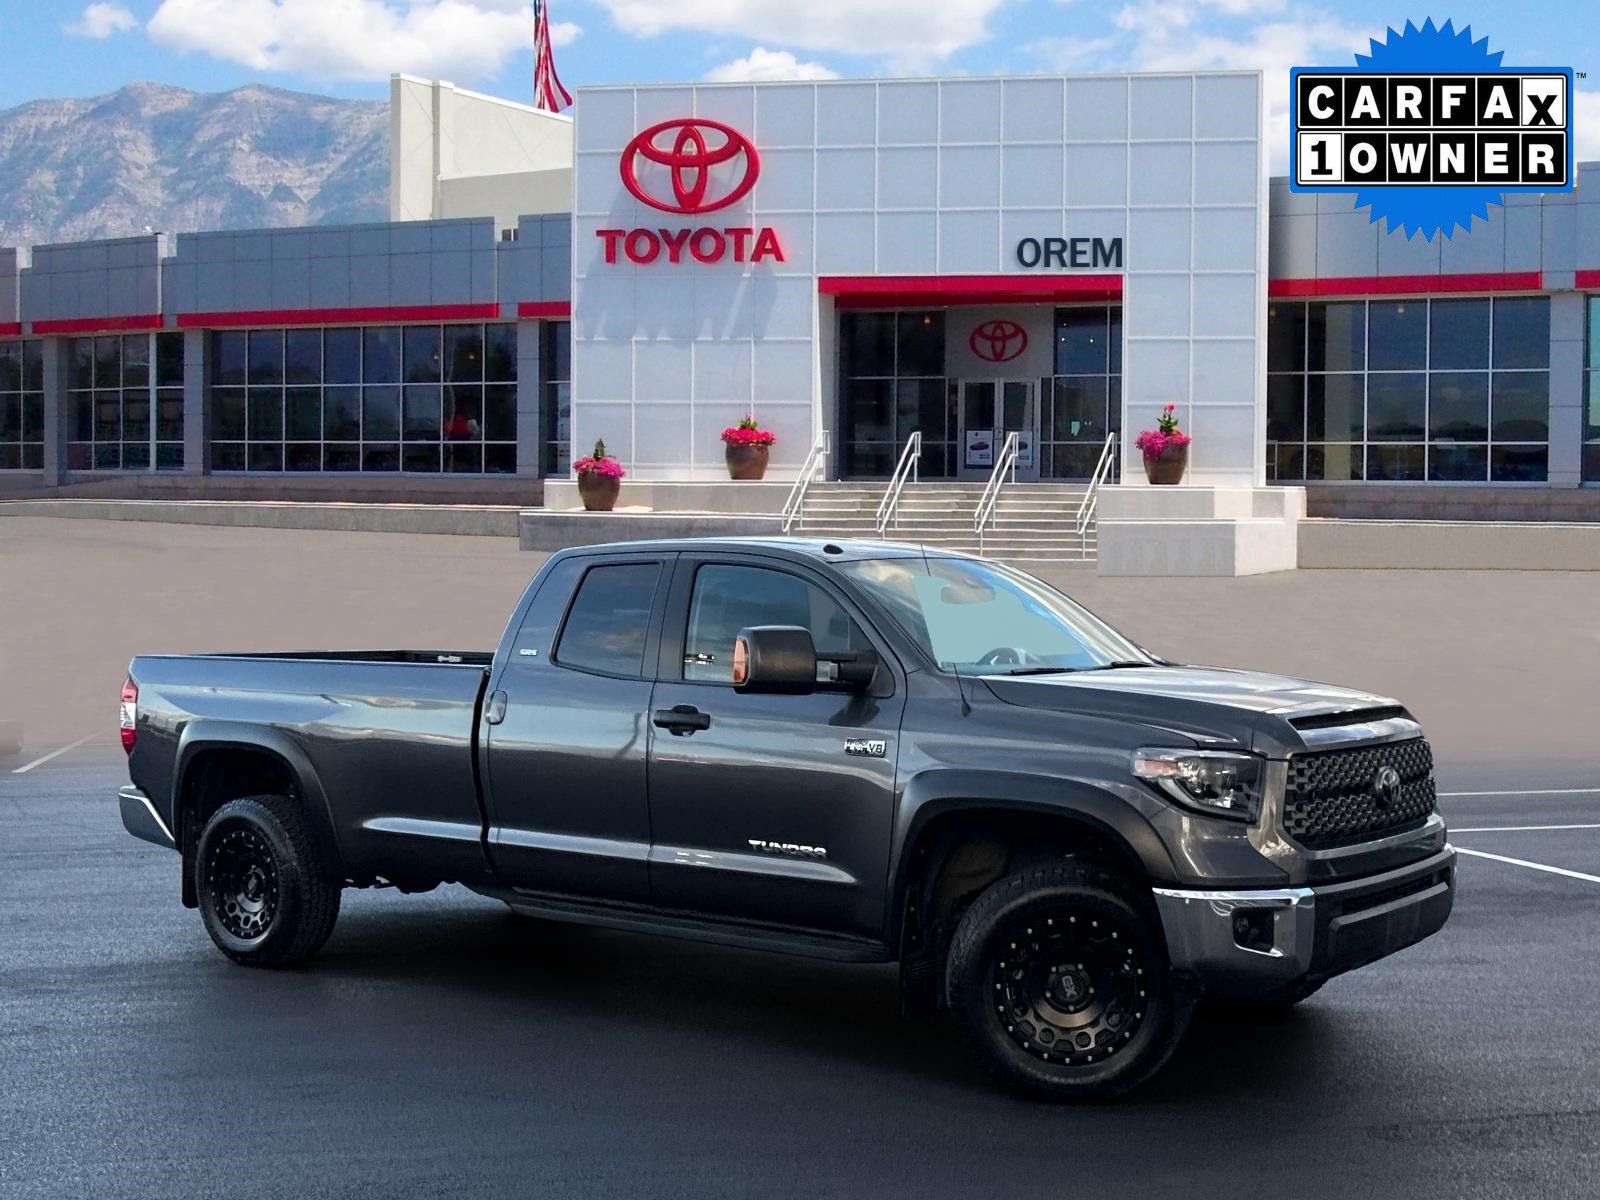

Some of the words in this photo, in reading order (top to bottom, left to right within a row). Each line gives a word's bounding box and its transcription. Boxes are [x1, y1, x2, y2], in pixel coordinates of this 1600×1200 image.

[595, 227, 785, 264] TOYOTA
[1017, 237, 1123, 268] OREM
[869, 743, 883, 754] V8
[748, 839, 827, 858] TUNDRA
